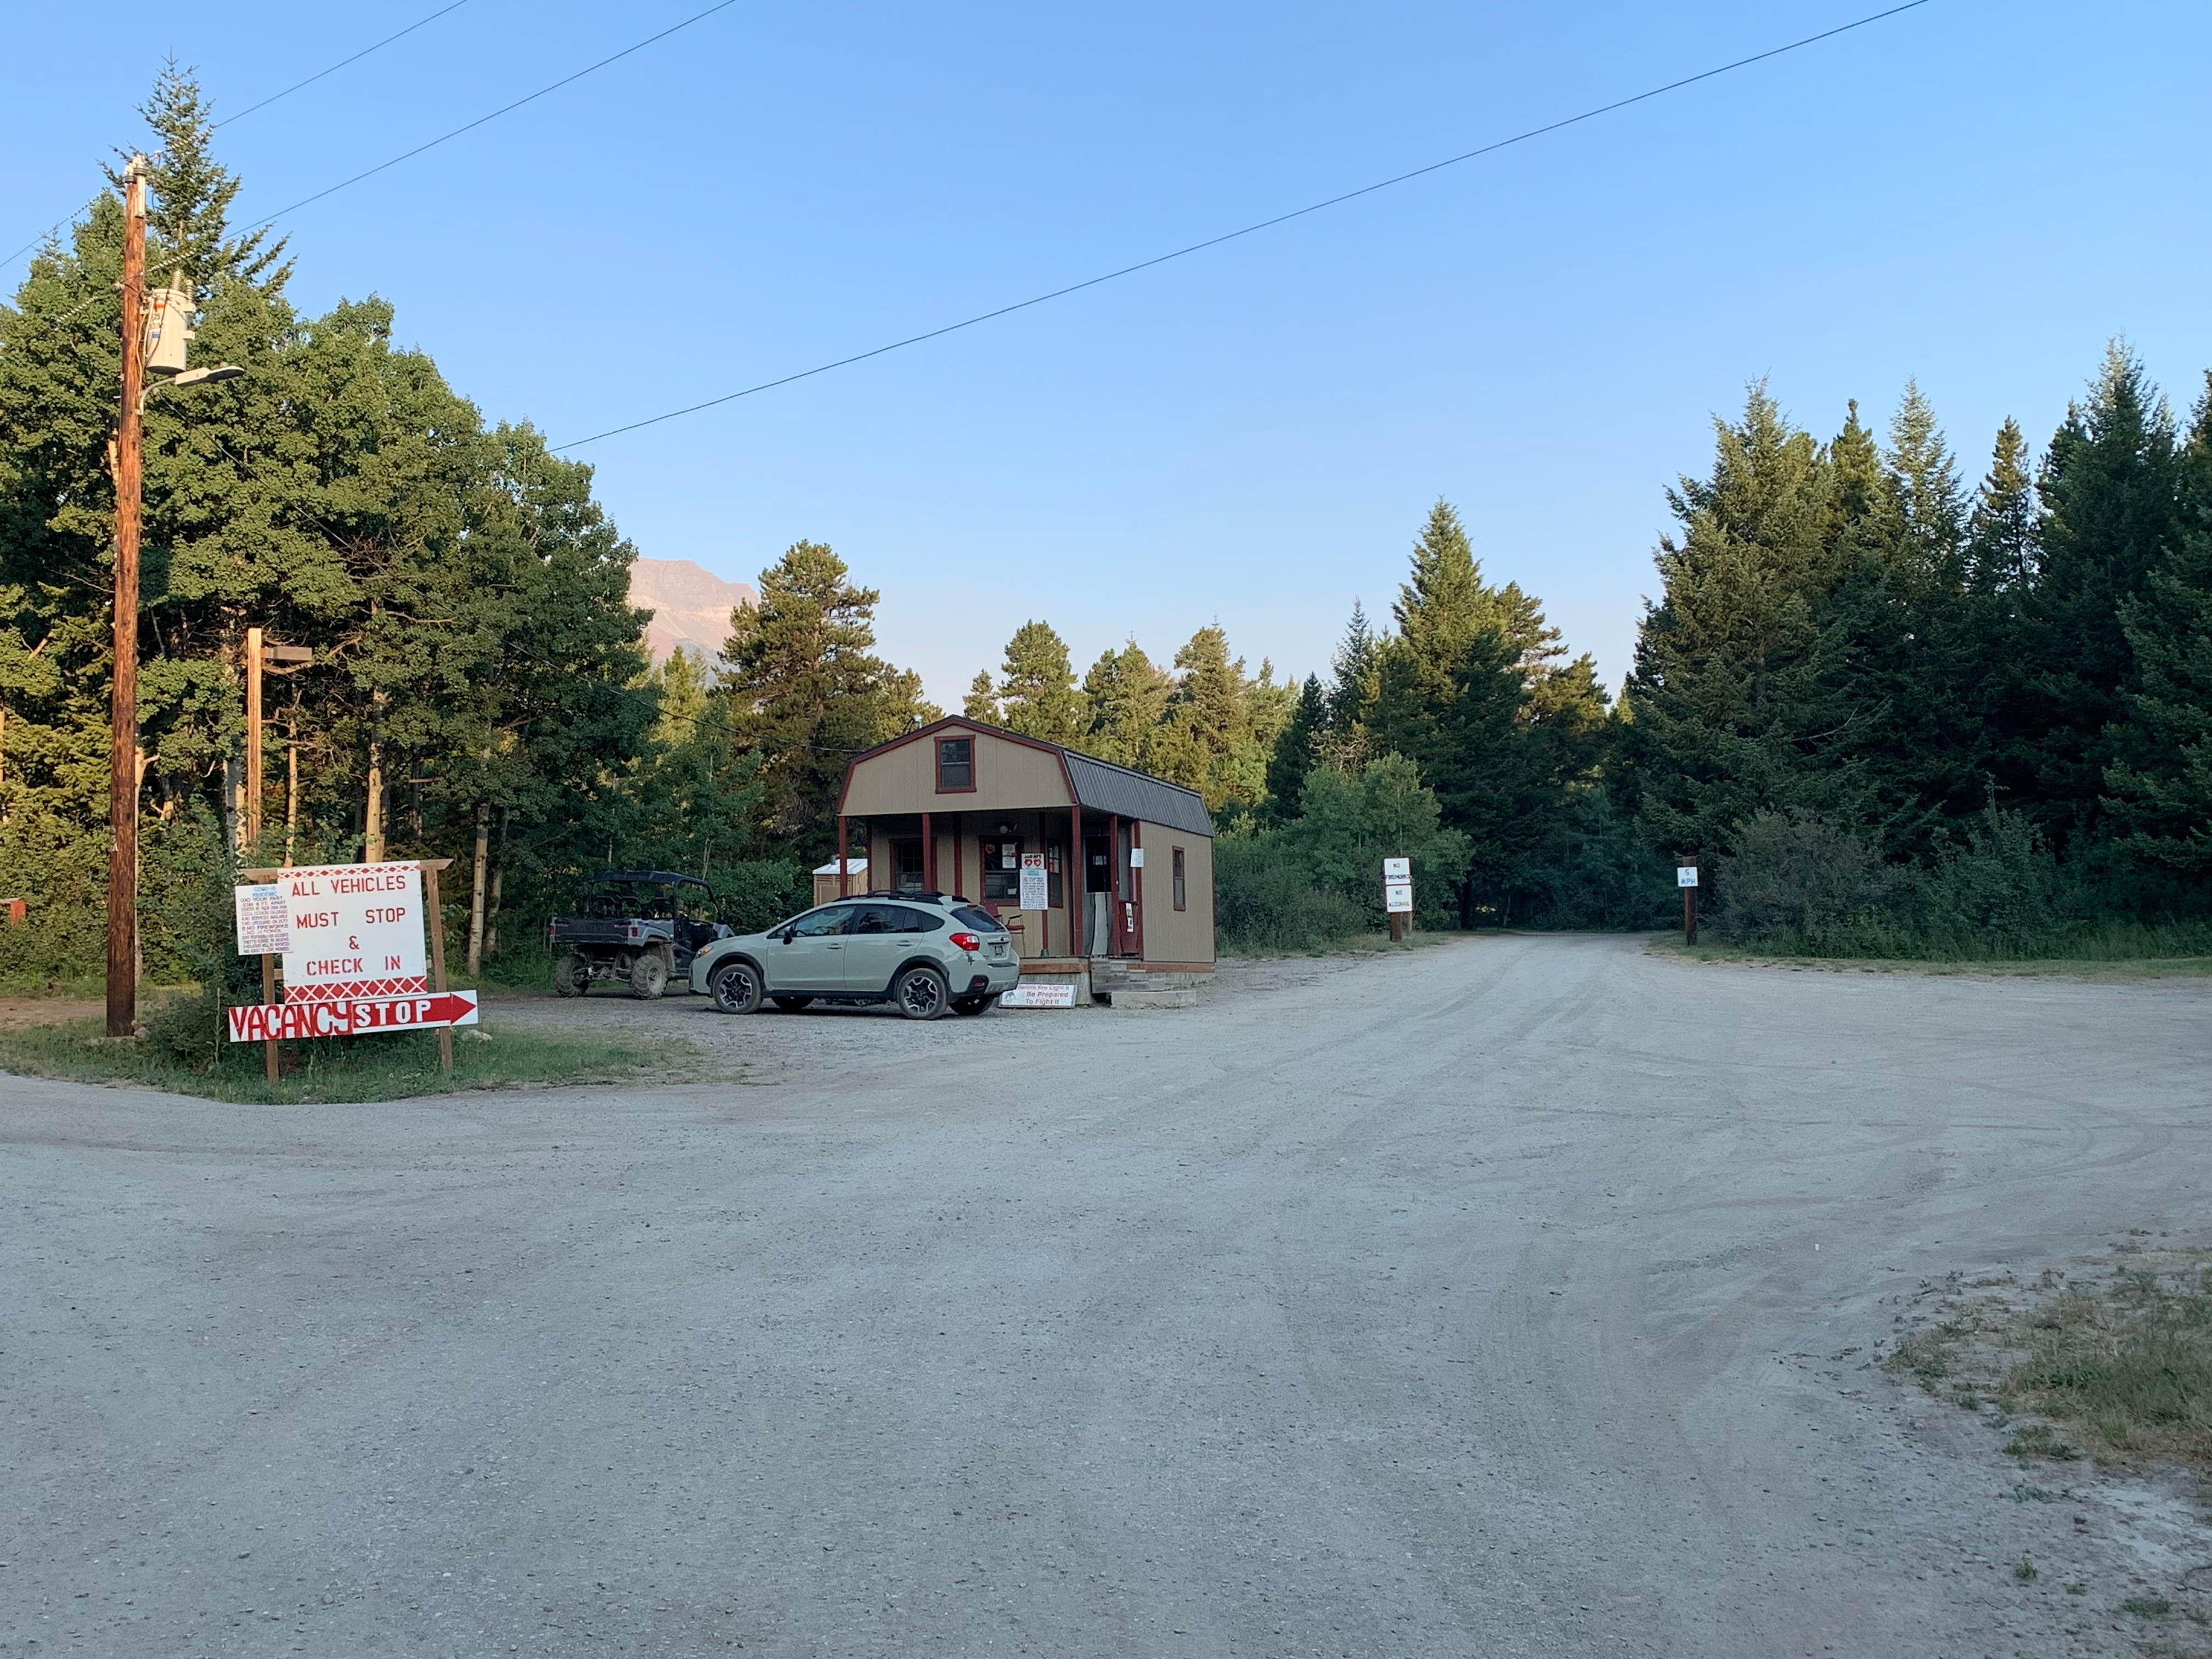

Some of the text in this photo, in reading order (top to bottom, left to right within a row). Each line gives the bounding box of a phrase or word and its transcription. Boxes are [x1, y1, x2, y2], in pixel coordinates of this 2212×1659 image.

[292, 875, 405, 896] ALL VEHICLES
[296, 907, 405, 929] MUST STOP
[349, 935, 359, 950] &
[307, 955, 400, 976] CHECK IN
[229, 1002, 351, 1041] VACANCY
[355, 1000, 431, 1027] STOP
